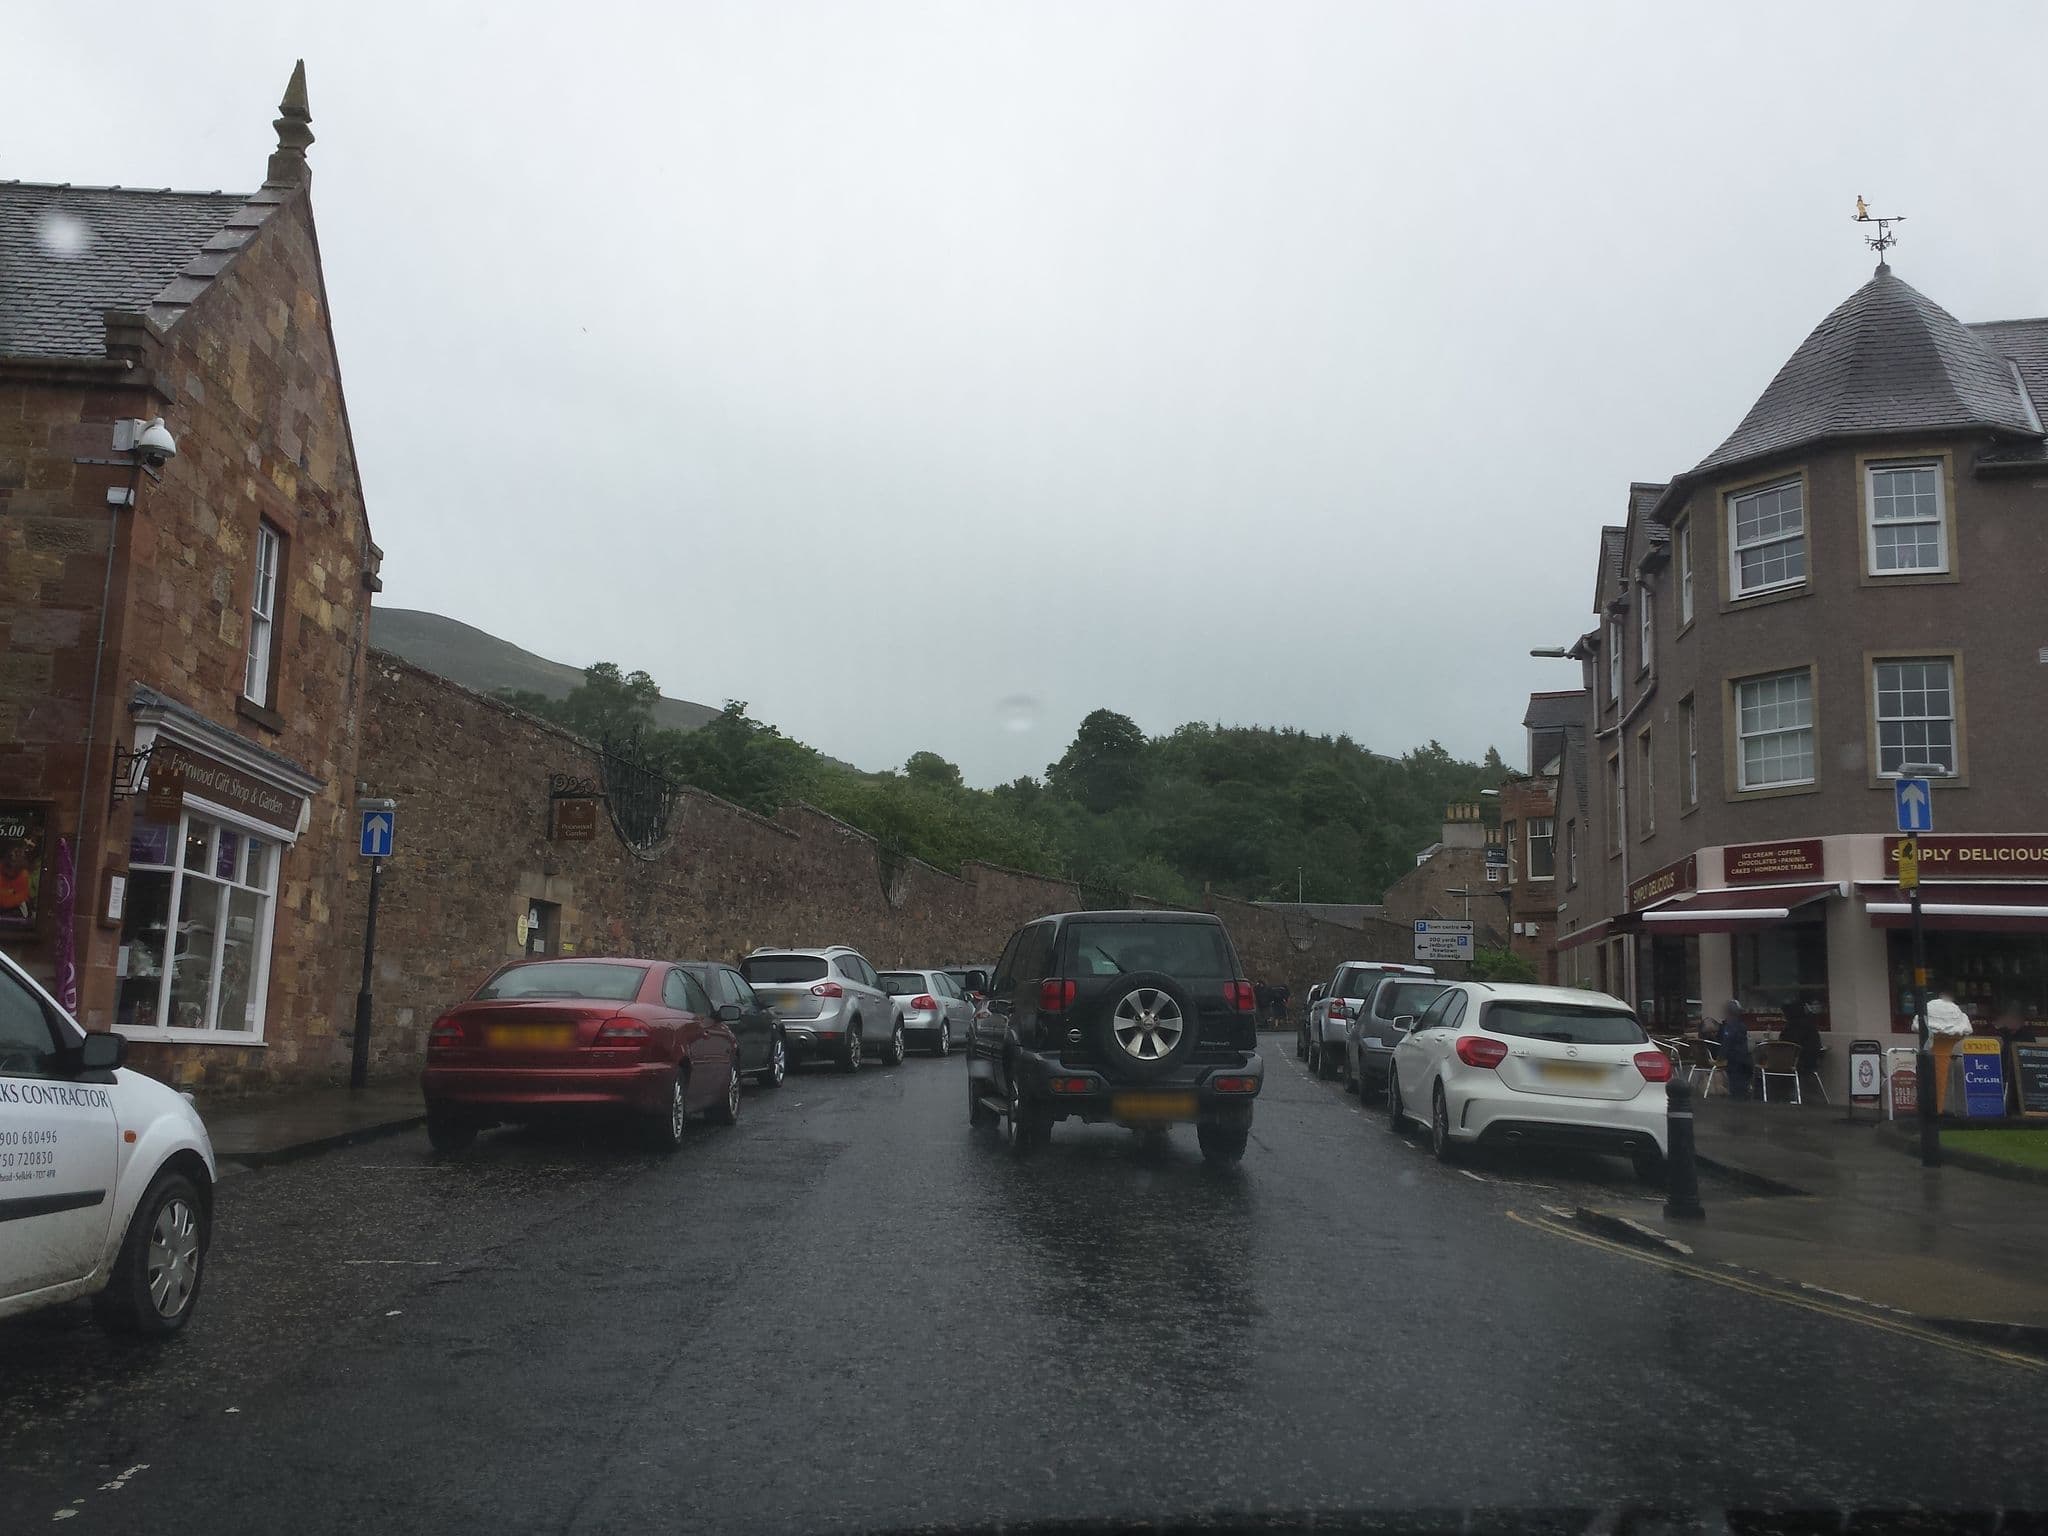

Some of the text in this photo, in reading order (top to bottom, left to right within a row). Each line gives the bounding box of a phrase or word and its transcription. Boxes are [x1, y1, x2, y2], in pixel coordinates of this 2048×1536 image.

[214, 772, 231, 793] Gift
[230, 780, 250, 805] Shop
[250, 787, 258, 803] &
[258, 790, 283, 815] Garden
[1752, 851, 1774, 859] CREAM
[1777, 848, 1801, 856] COFFEE
[1737, 858, 1777, 867] CHOCOLATES
[1731, 867, 1751, 875] CAKES
[1754, 865, 1790, 873] HOMEMADE
[1648, 871, 1675, 897] DELICIOUS
[1975, 1059, 1990, 1070] Ice
[1965, 1071, 2000, 1084] Cream
[21, 1084, 109, 1108] CONTRACTOR
[21, 1130, 58, 1145] 680496
[17, 1150, 54, 1166] 720830
